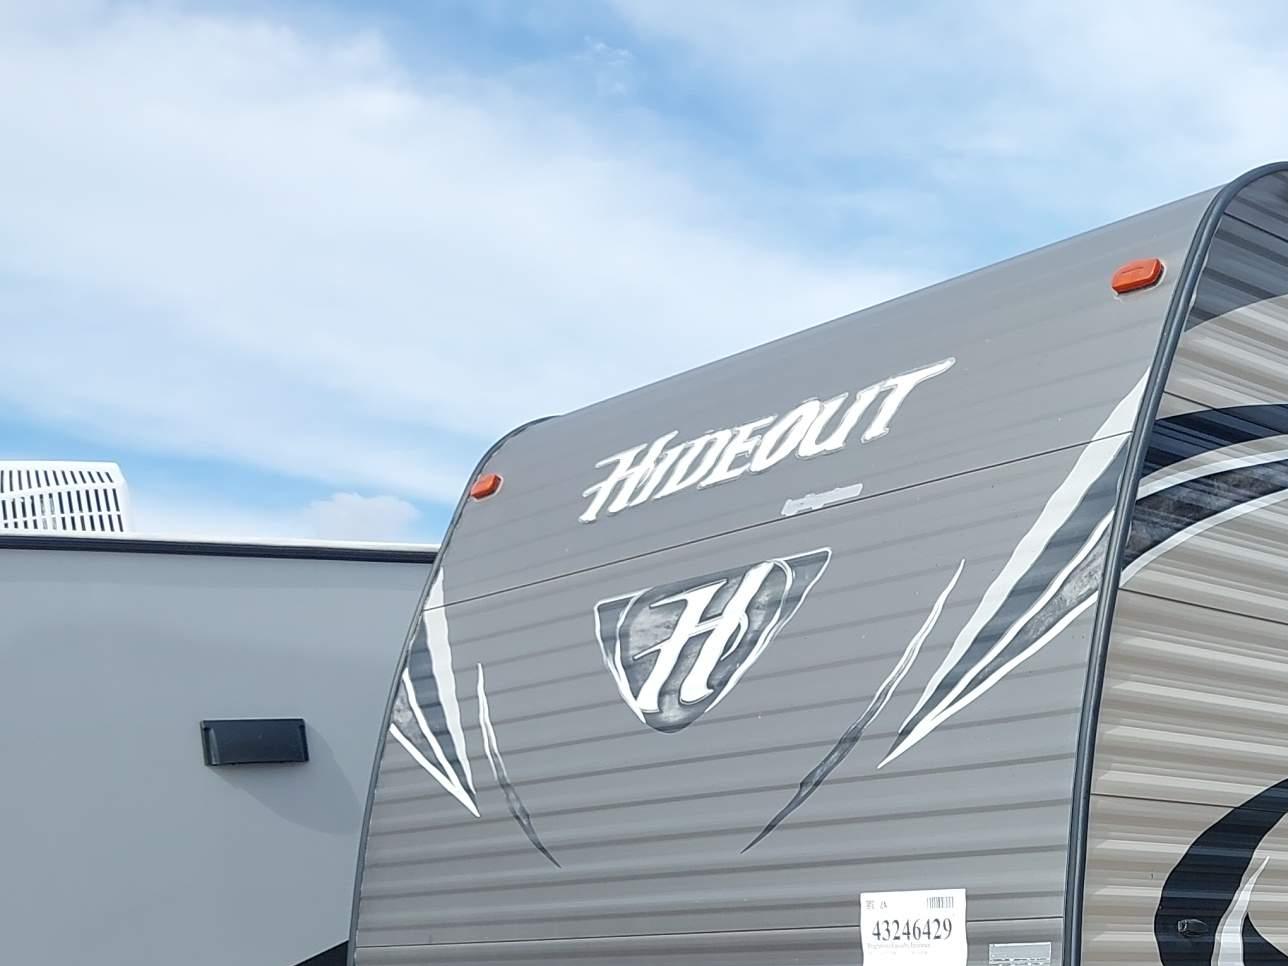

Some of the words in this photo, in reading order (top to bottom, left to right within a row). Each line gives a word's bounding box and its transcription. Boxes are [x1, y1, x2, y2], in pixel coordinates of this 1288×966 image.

[578, 356, 957, 524] HIDEOUT
[632, 559, 776, 714] H
[871, 917, 953, 941] 43246429
